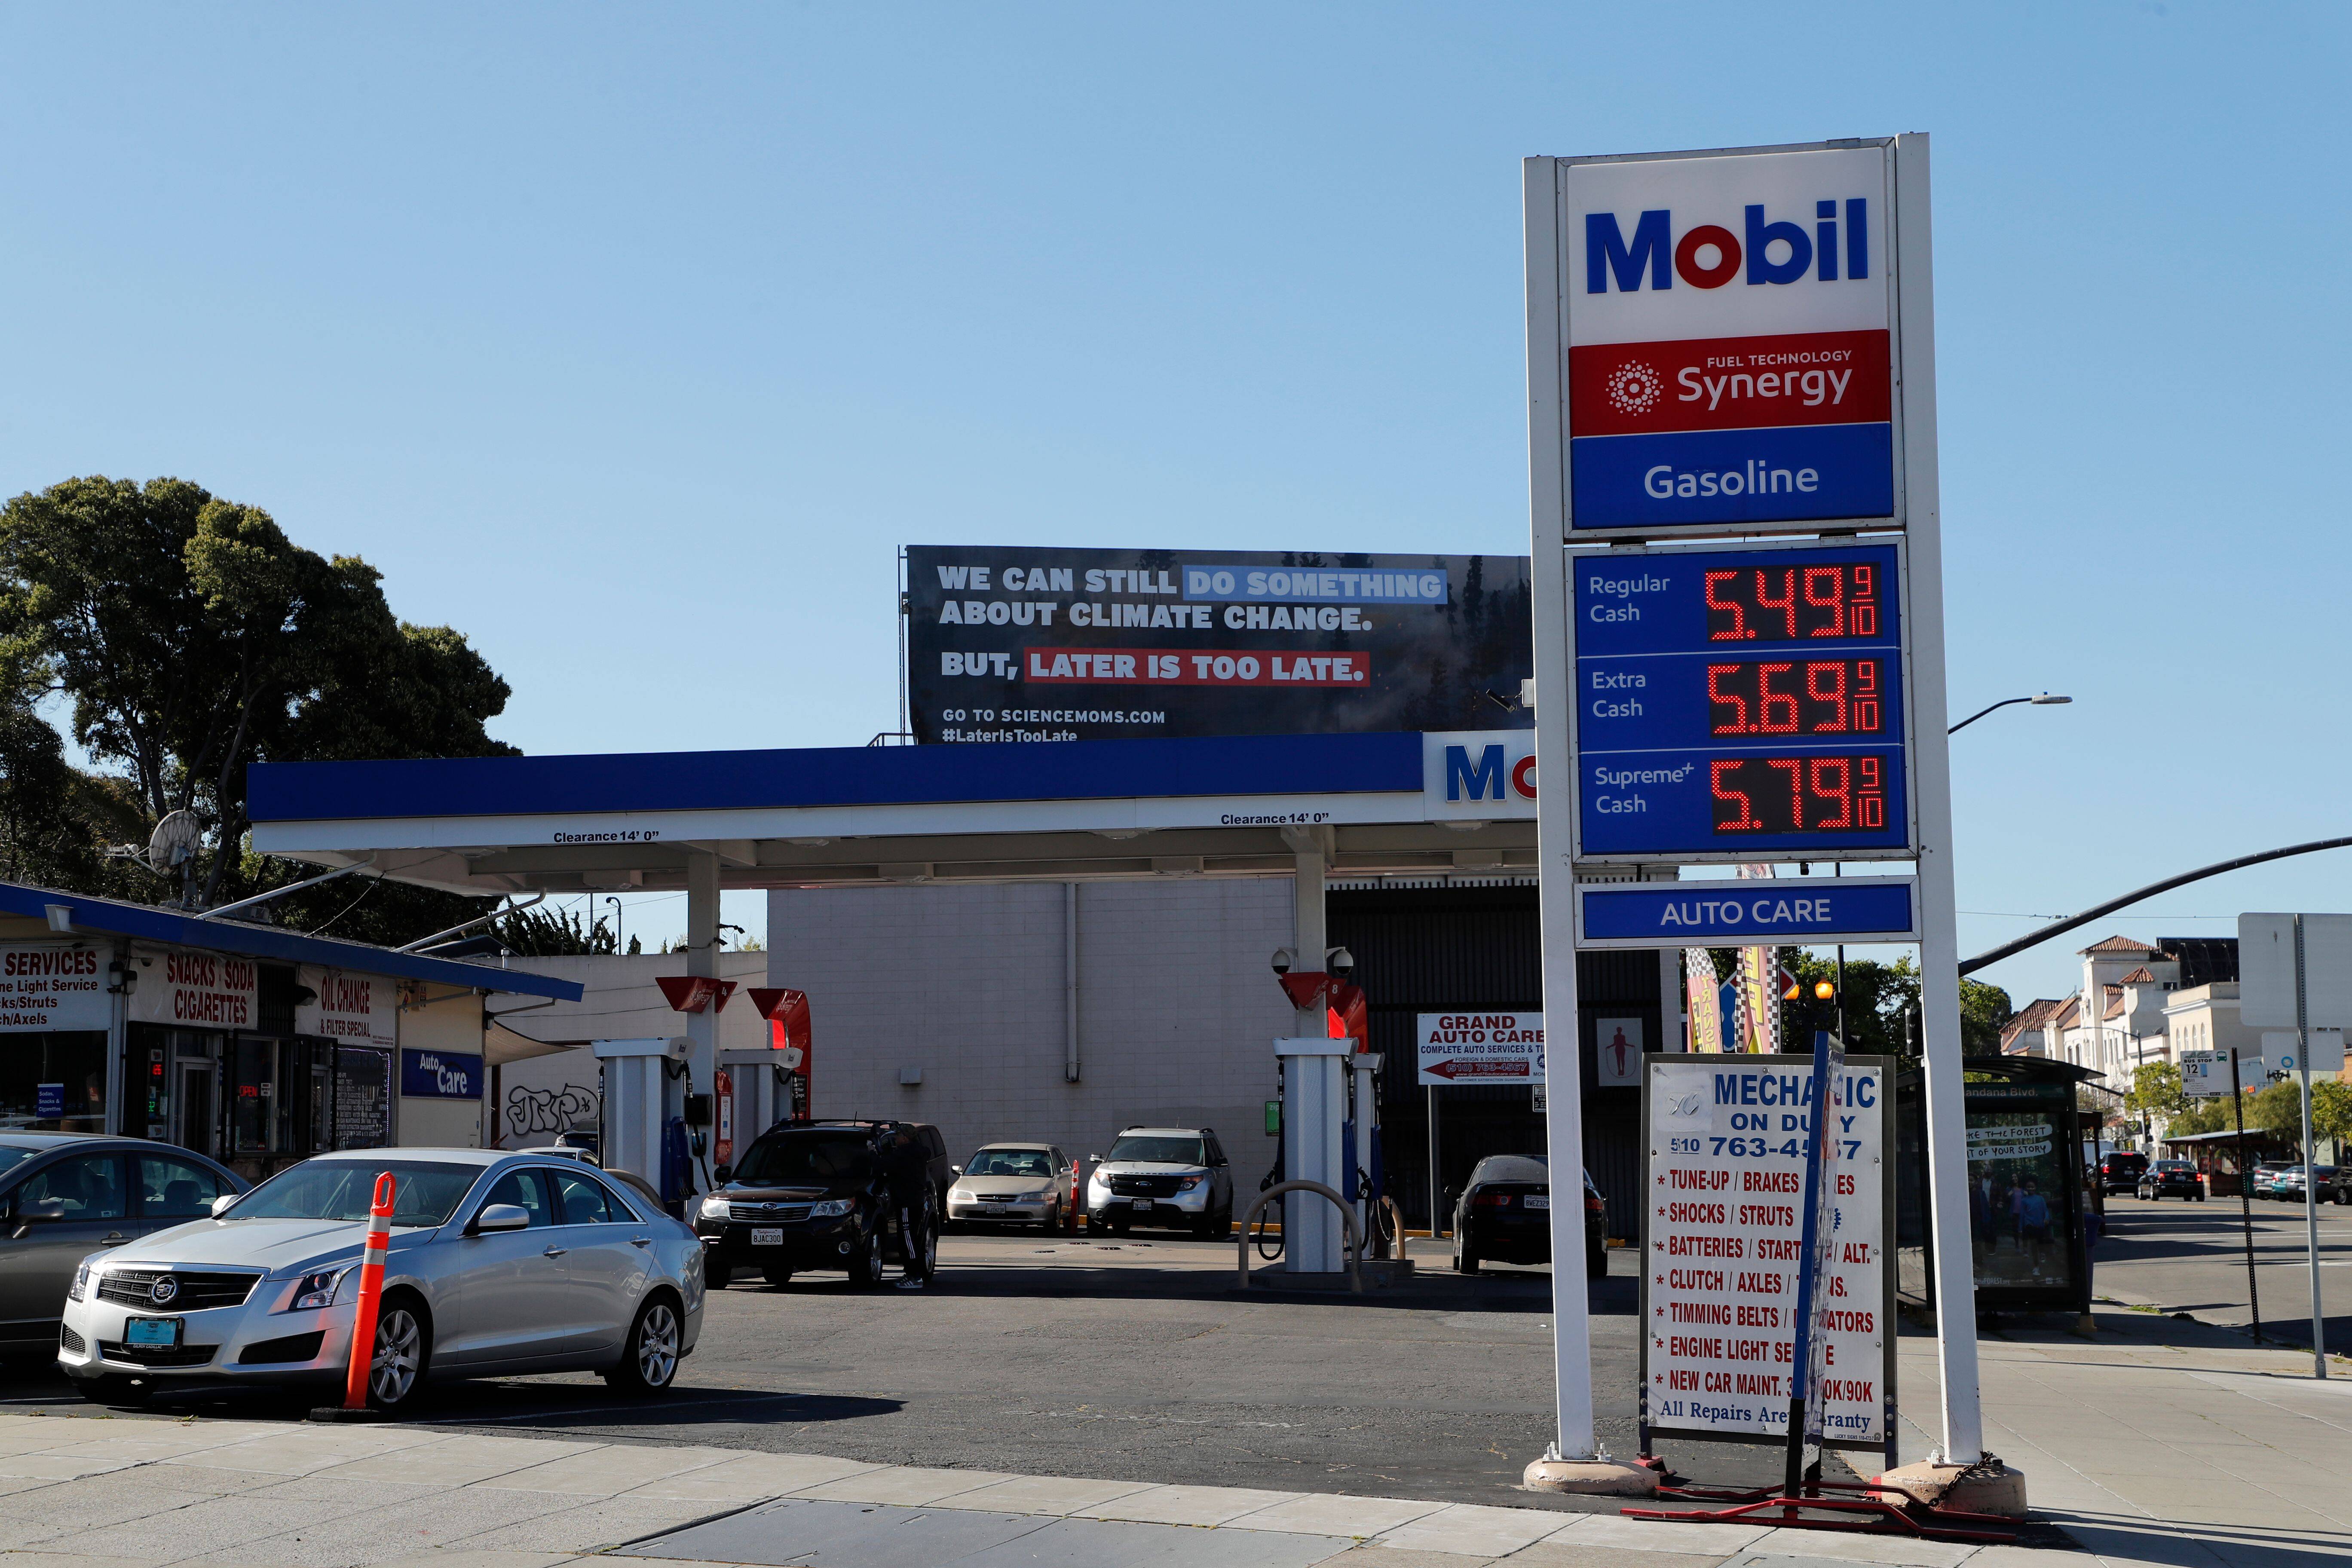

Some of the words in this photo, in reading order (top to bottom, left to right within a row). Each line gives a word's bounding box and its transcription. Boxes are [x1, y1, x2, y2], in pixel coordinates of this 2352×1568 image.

[1586, 198, 1868, 294] Mobil
[1707, 355, 1743, 368] FUEL
[1749, 350, 1852, 366] TECHNOLOGY
[1678, 366, 1853, 410] Synergy
[1644, 459, 1818, 499] Gasoline
[937, 566, 990, 590] WE
[1002, 567, 1073, 591] CAN
[1085, 569, 1177, 594] STILL
[1189, 571, 1235, 595] DO
[1247, 572, 1441, 598] SOMETHING
[1590, 574, 1670, 598] Regular
[1590, 603, 1640, 622] Cash
[1705, 567, 1844, 640] 5.49
[939, 600, 1057, 625] ABOUT
[1069, 603, 1212, 628] CLIMATE
[1224, 606, 1372, 631] CHANGE.
[941, 652, 1018, 680] BUT,
[1031, 653, 1136, 678] LATER
[1148, 655, 1180, 679] IS
[1192, 656, 1260, 680] TOO
[1272, 657, 1364, 681] LATE.
[1592, 671, 1646, 689] Extra
[1592, 699, 1642, 717] Cash
[1707, 662, 1846, 734] 5.69
[943, 709, 966, 721] GO
[973, 709, 995, 722] TO
[1001, 710, 1165, 723] SCIENCEMOMS.COM
[943, 729, 1078, 742] #LaterIsTooLate
[1596, 795, 1646, 813] Cash
[1711, 758, 1850, 830] 5.79
[1221, 814, 1286, 824] Clearance
[554, 833, 618, 842] Clearance
[1660, 901, 1743, 925] AUTO
[1752, 899, 1831, 923] CARE
[4, 951, 97, 977] SERVICES
[167, 952, 215, 987] SNACKS
[224, 960, 254, 991] SODA
[17, 980, 48, 994] Light
[52, 978, 98, 992] Service
[321, 976, 335, 1011] OIL
[337, 977, 370, 1014] CHANGE
[722, 986, 727, 996] 4
[1332, 984, 1338, 994] 8
[0, 995, 58, 1010] ks/Struts
[174, 989, 247, 1024] CIGARETTES
[320, 1018, 325, 1034] &
[327, 1019, 346, 1035] FILTER
[347, 1020, 371, 1037] SPECIAL
[1439, 1016, 1516, 1029] GRAND
[1429, 1030, 1486, 1044] AUTO
[1492, 1030, 1545, 1043] CARE
[1421, 1045, 1461, 1054] COMPLETE
[1464, 1045, 1484, 1054] AUTO
[1487, 1045, 1525, 1054] SERVICES
[1528, 1045, 1533, 1053] &
[420, 1054, 439, 1070] Auto
[1446, 1063, 1473, 1072] (510)
[1476, 1063, 1527, 1072] 763-4567
[2186, 1064, 2198, 1073] 12
[437, 1065, 467, 1093] Care
[239, 1085, 258, 1097] OPEN
[1715, 1074, 1876, 1108] MECHAIC
[1966, 1088, 2006, 1096] andana
[2010, 1087, 2038, 1096] Blvd.
[1731, 1113, 1767, 1131] ON
[1782, 1115, 1856, 1133] DUY
[1966, 1131, 1980, 1139] KE
[2010, 1127, 2046, 1137] FOREST
[1671, 1138, 1700, 1152] 510
[1709, 1137, 1862, 1160] 763-47
[1992, 1146, 2015, 1156] YOUR
[2018, 1145, 2046, 1156] STORY
[1670, 1169, 1729, 1191] TUNE-UP
[1744, 1171, 1799, 1193] BRAKES
[1669, 1202, 1725, 1224] SHOCKS
[1740, 1205, 1793, 1227] STRUTS
[753, 1234, 781, 1243] 8JAC300
[1670, 1235, 1743, 1259] BATTERIES
[1843, 1243, 1871, 1264] ALT.
[1670, 1268, 1723, 1292] CLUTCH
[1737, 1272, 1782, 1295] AXLES
[1670, 1302, 1731, 1325] TIMMING
[1737, 1305, 1778, 1328] BELTS
[1670, 1336, 1721, 1359] ENGINE
[1727, 1340, 1769, 1362] LIGHT
[1670, 1370, 1700, 1391] NEW
[1705, 1372, 1731, 1393] CAR
[1737, 1374, 1782, 1396] MAINT.
[1661, 1401, 1683, 1417] All
[1690, 1402, 1752, 1423] Repairs
[1758, 1406, 1788, 1424] Are
[1823, 1413, 1871, 1433] ranty
